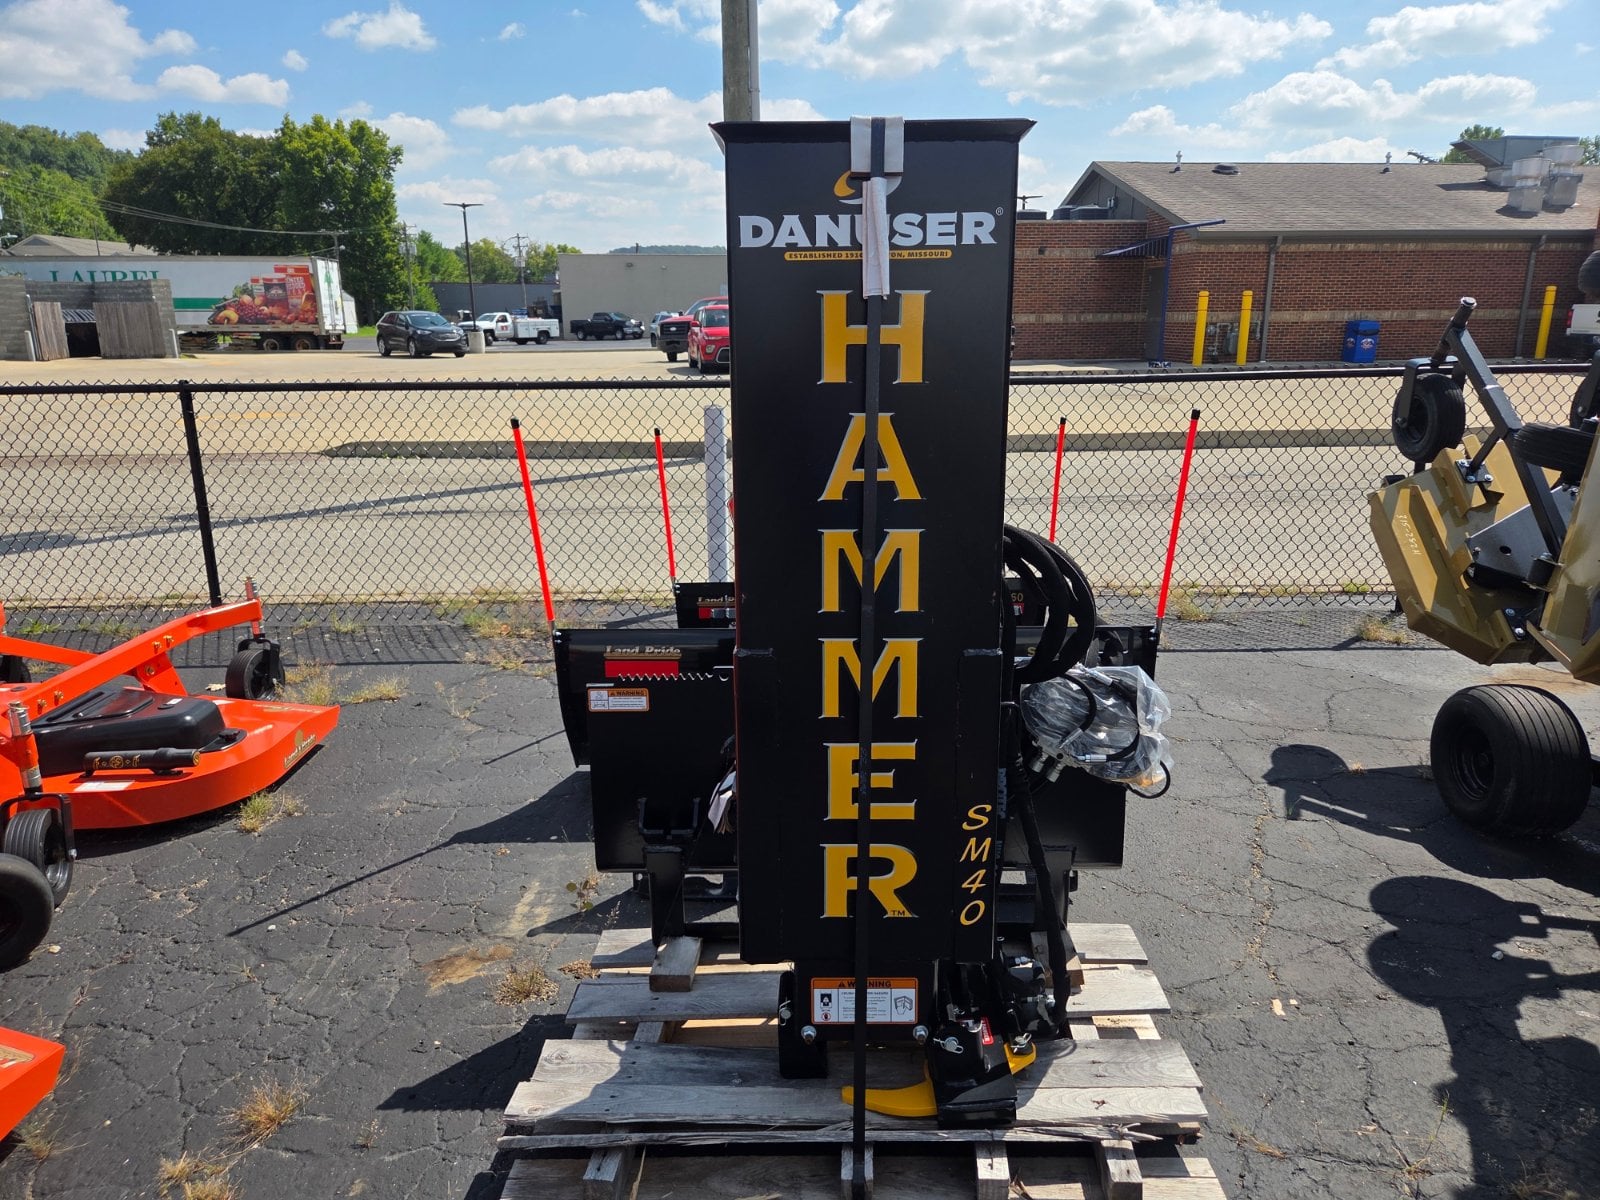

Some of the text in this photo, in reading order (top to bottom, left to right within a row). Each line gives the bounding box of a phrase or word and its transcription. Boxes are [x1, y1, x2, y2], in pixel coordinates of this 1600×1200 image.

[739, 211, 997, 248] DANSER
[789, 252, 843, 260] ESTABLISHED
[907, 250, 949, 258] MISSOURI
[815, 289, 932, 918] HAMMER
[606, 645, 681, 653] Land Pride
[959, 804, 993, 926] SM40
[847, 980, 892, 988] WNING
